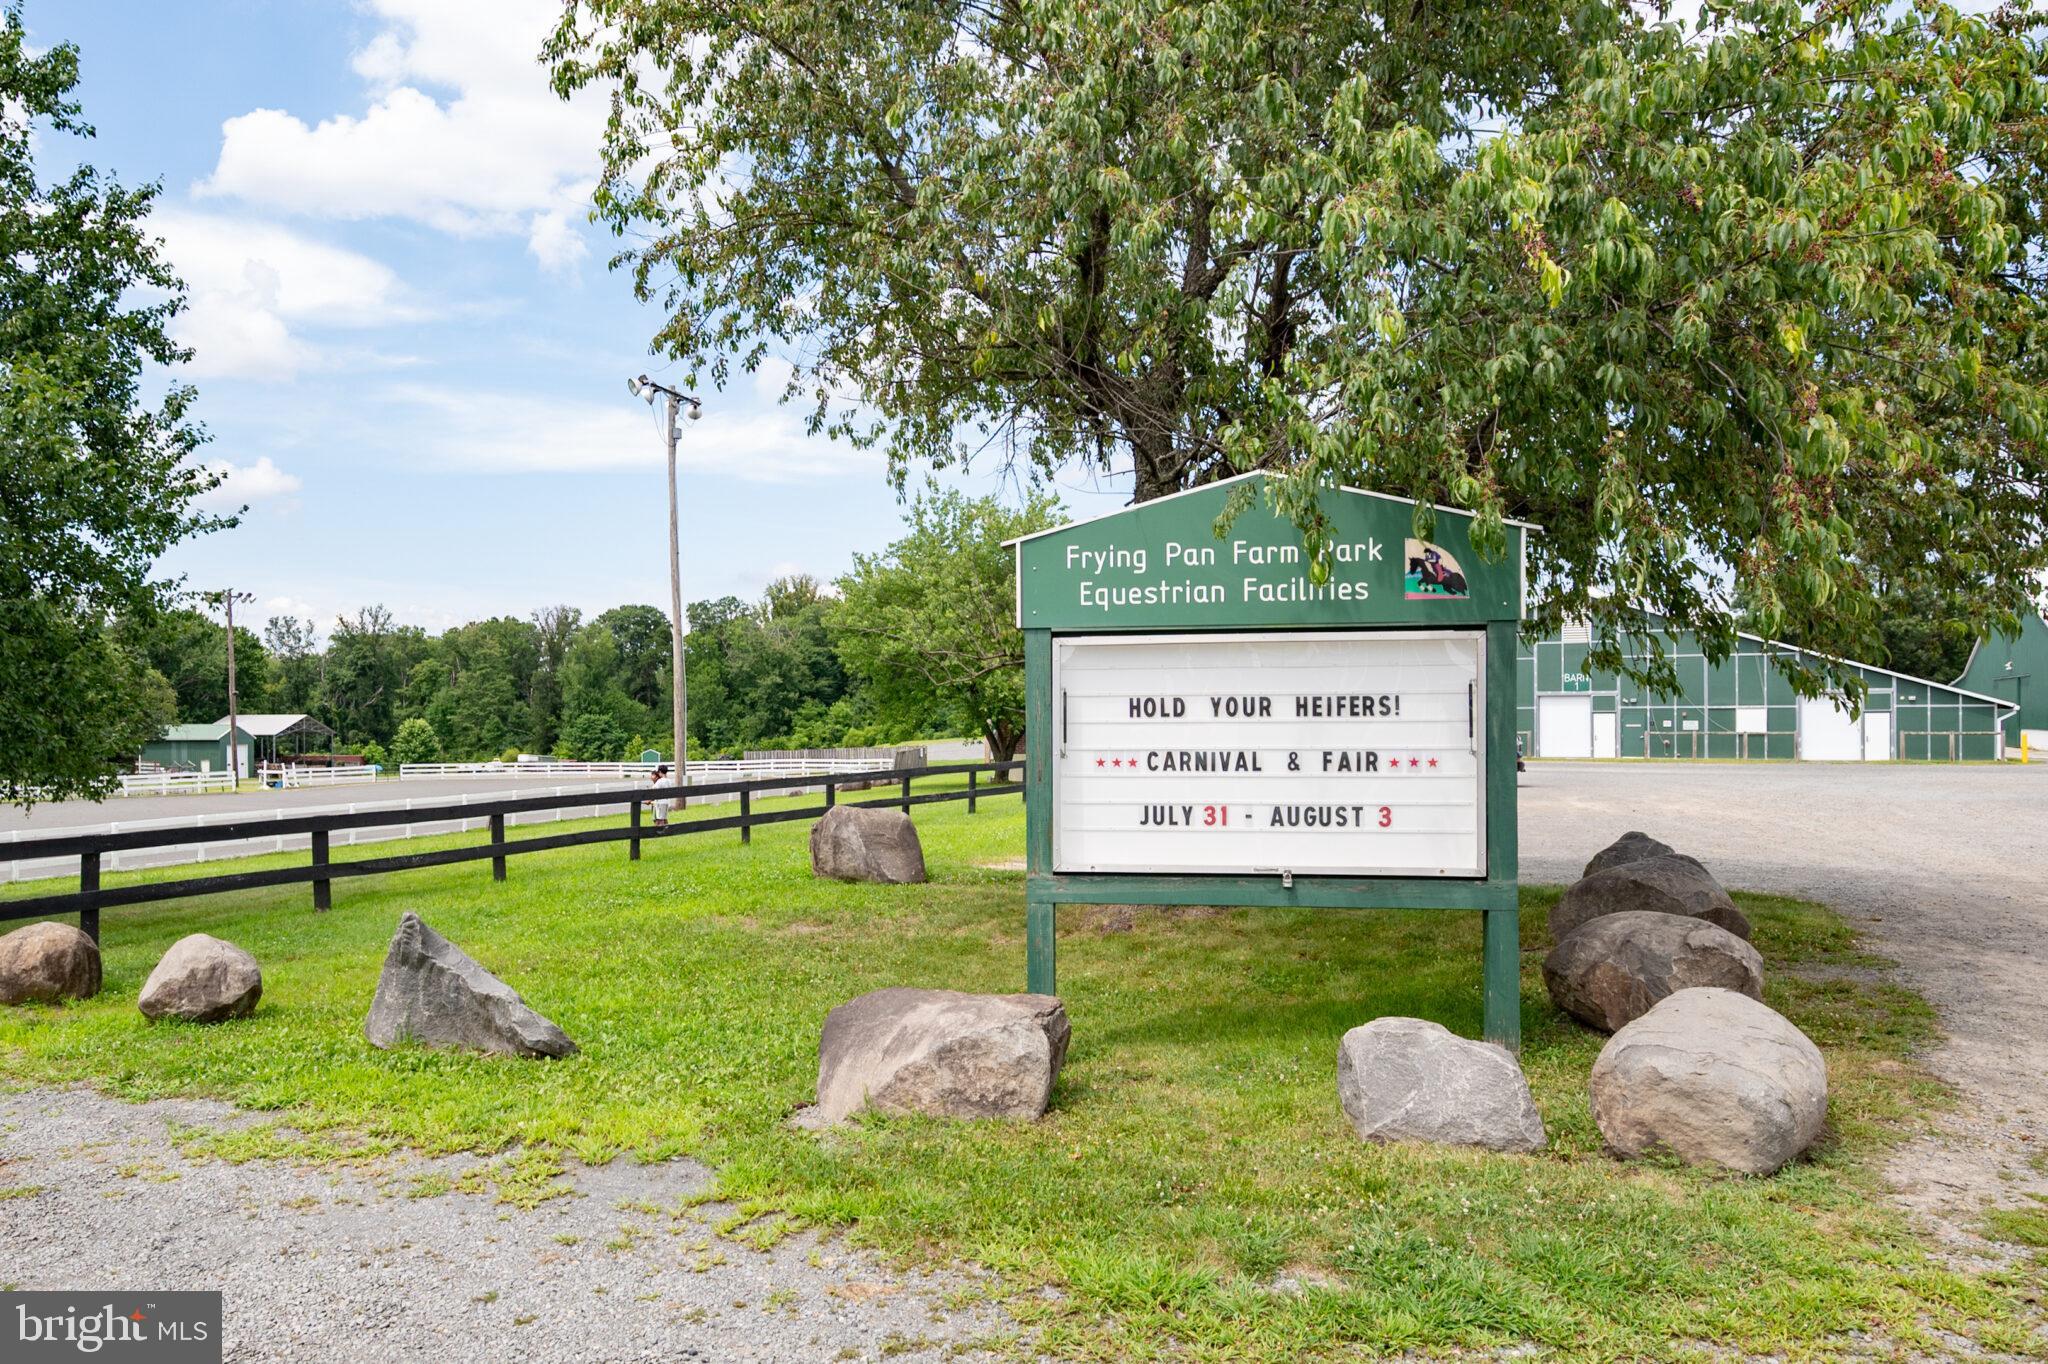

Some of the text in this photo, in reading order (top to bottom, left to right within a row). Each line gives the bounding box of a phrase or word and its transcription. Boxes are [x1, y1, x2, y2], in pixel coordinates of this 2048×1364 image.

[1066, 538, 1383, 575] Frying Pan Farm Park
[1080, 577, 1369, 612] Equestrian Facilities
[1564, 673, 1589, 682] BARN
[1574, 682, 1579, 691] 1
[1129, 695, 1400, 718] HOLD YOUR HEIFERS!
[1147, 752, 1378, 772] CARNIVAL & FAIR
[1139, 806, 1193, 826] JULY
[1203, 806, 1227, 826] 31
[1270, 807, 1364, 827] AUGUST
[1378, 807, 1392, 828] 3
